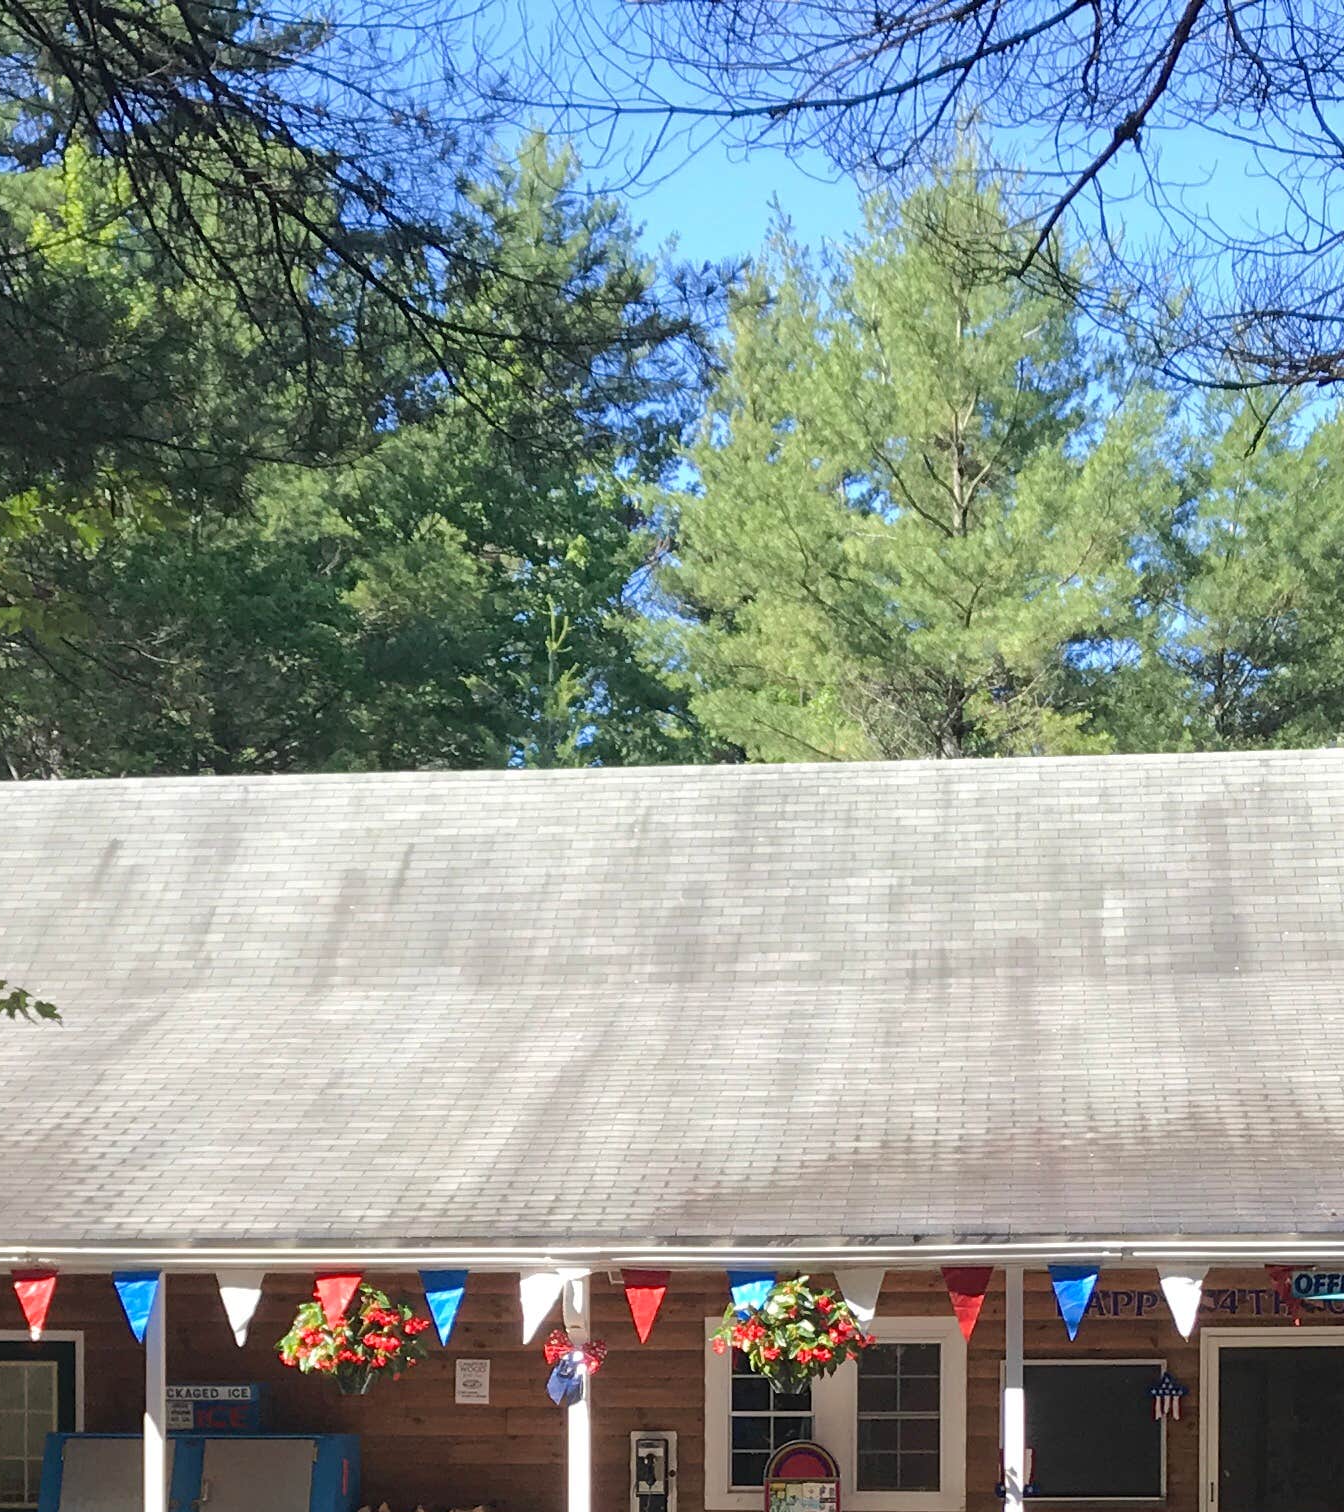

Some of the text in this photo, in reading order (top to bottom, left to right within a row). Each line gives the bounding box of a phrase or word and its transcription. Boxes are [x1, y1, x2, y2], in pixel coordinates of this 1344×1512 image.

[1056, 1290, 1166, 1316] APP
[165, 1389, 249, 1398] CKAGED ICE
[197, 1405, 249, 1428] ICE
